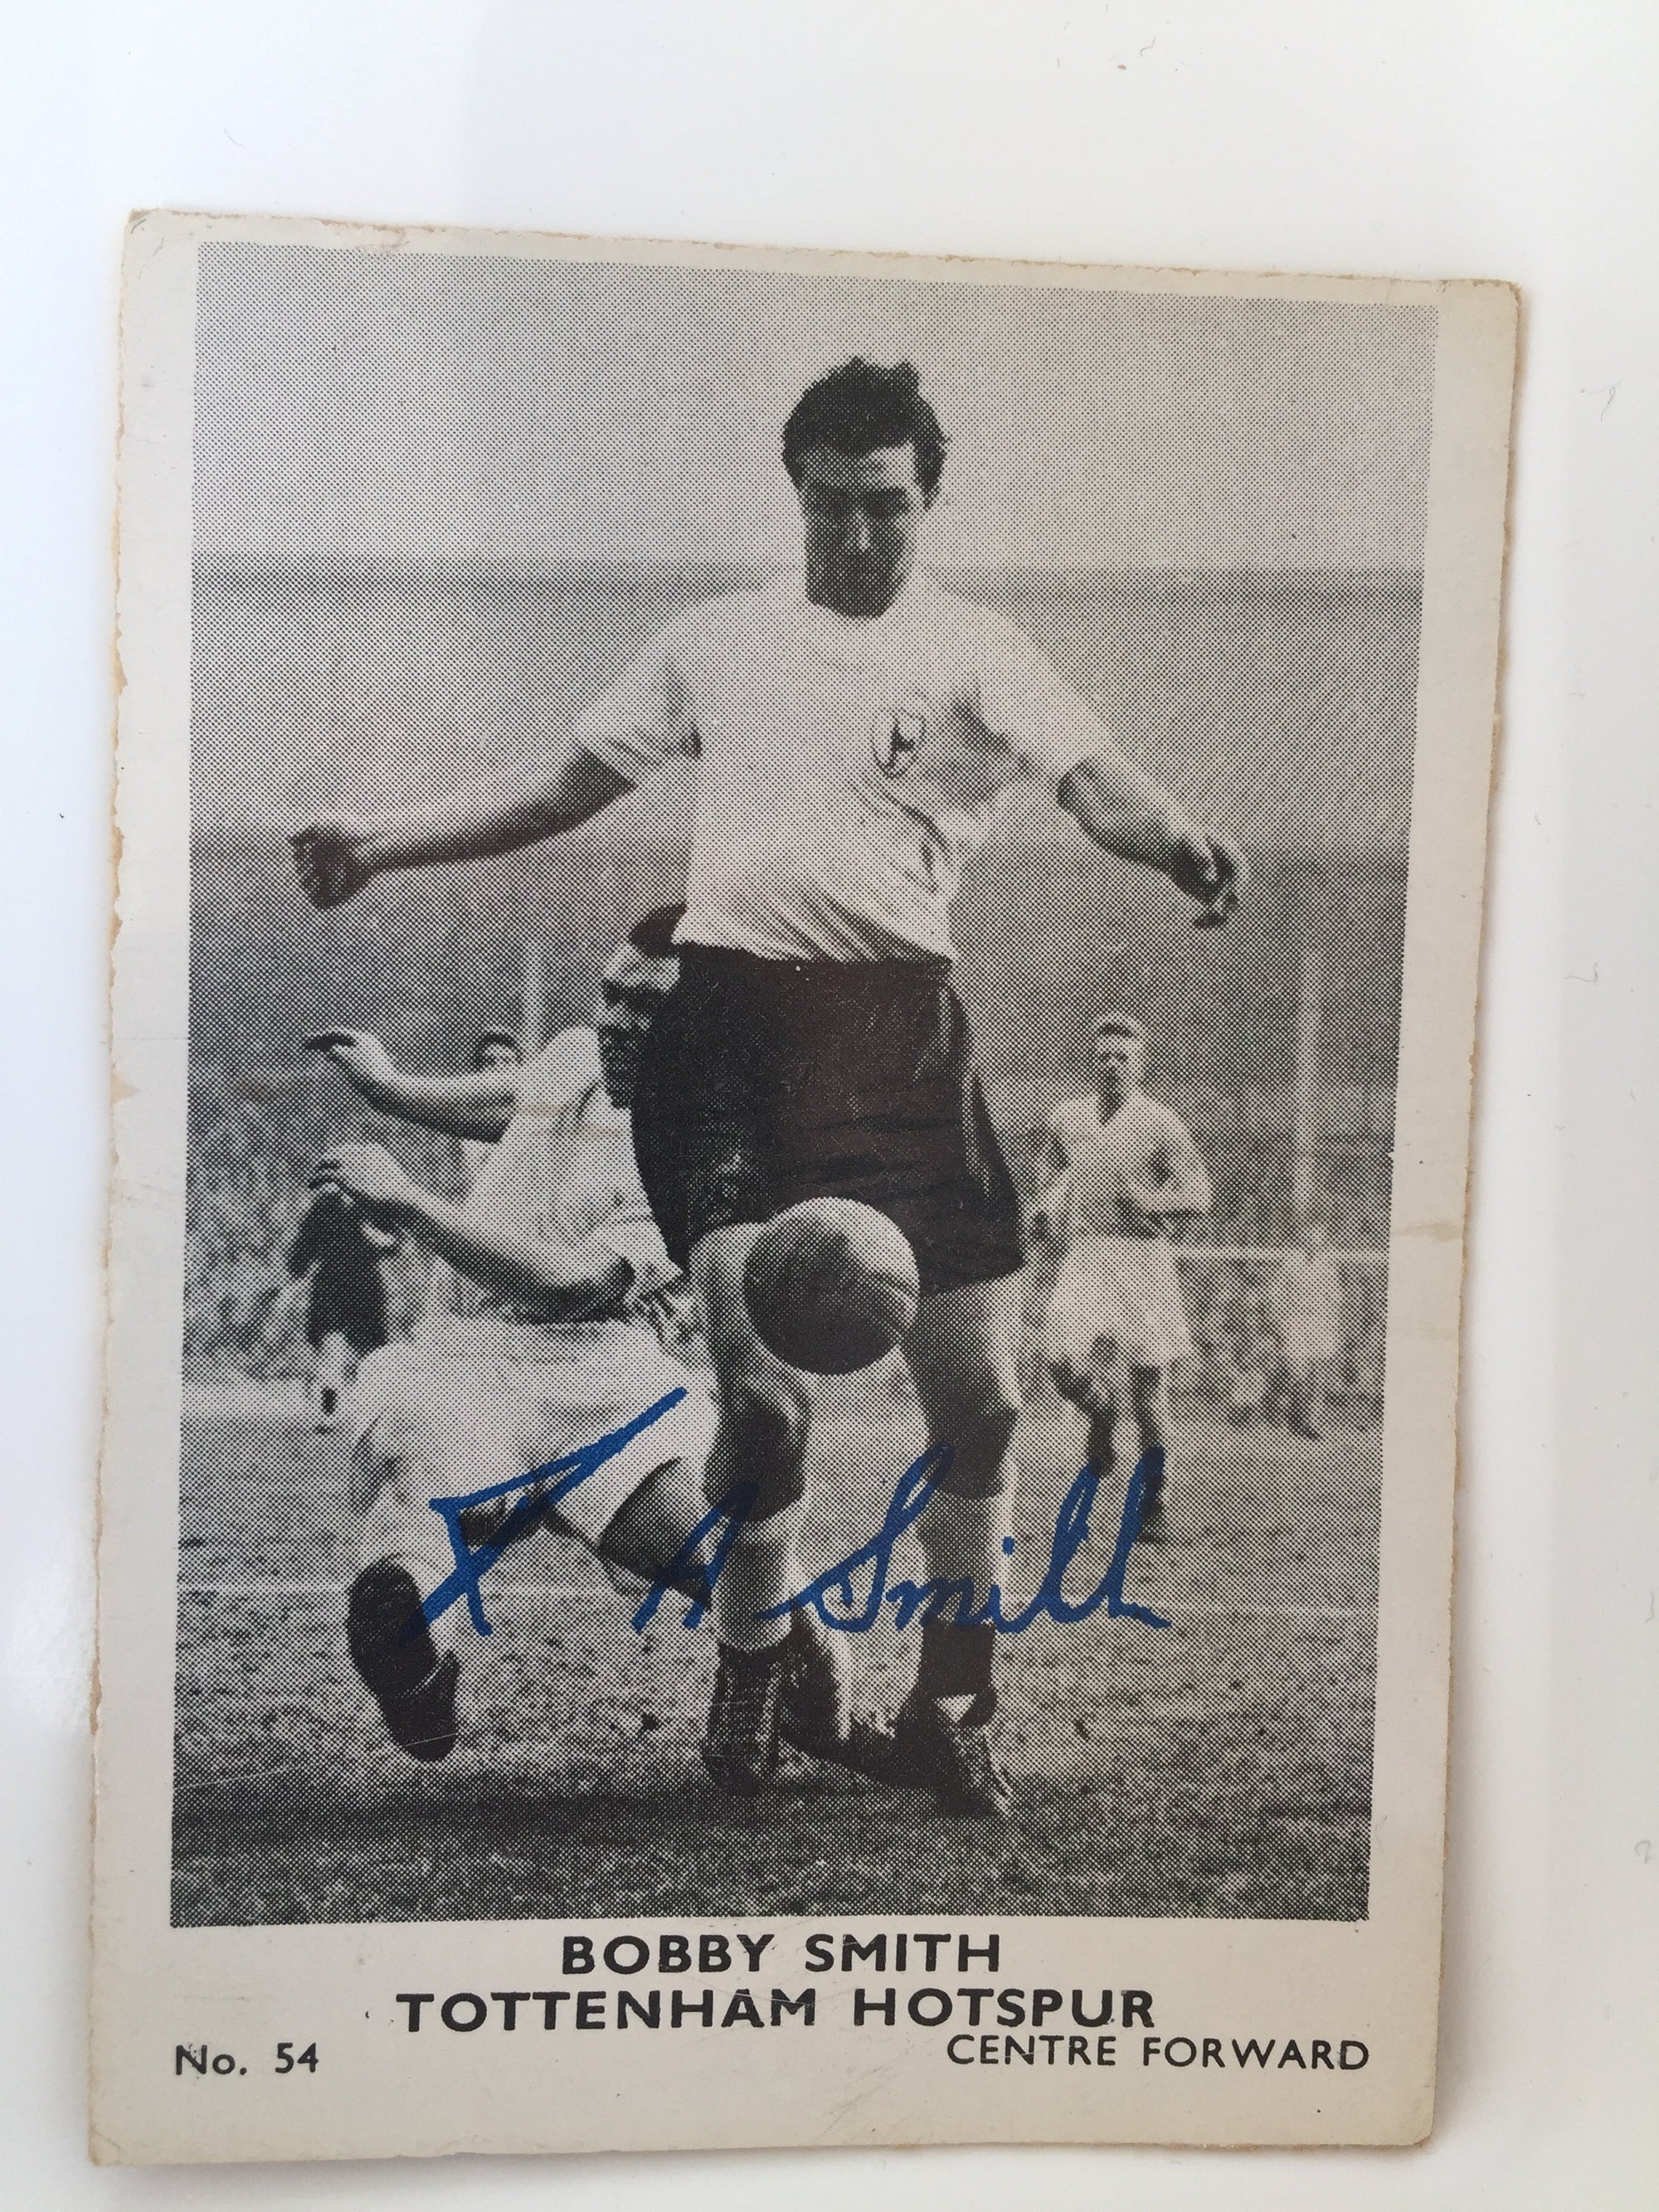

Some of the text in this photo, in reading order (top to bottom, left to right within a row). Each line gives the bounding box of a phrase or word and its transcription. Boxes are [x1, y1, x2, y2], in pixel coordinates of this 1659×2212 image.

[562, 1933, 1000, 1975] BOBBY SMITH
[396, 1987, 1155, 2033] TOTTENHAM HOTSPUR
[174, 2041, 320, 2077] No. 54
[946, 2034, 1370, 2072] CENTRE FORWARD
